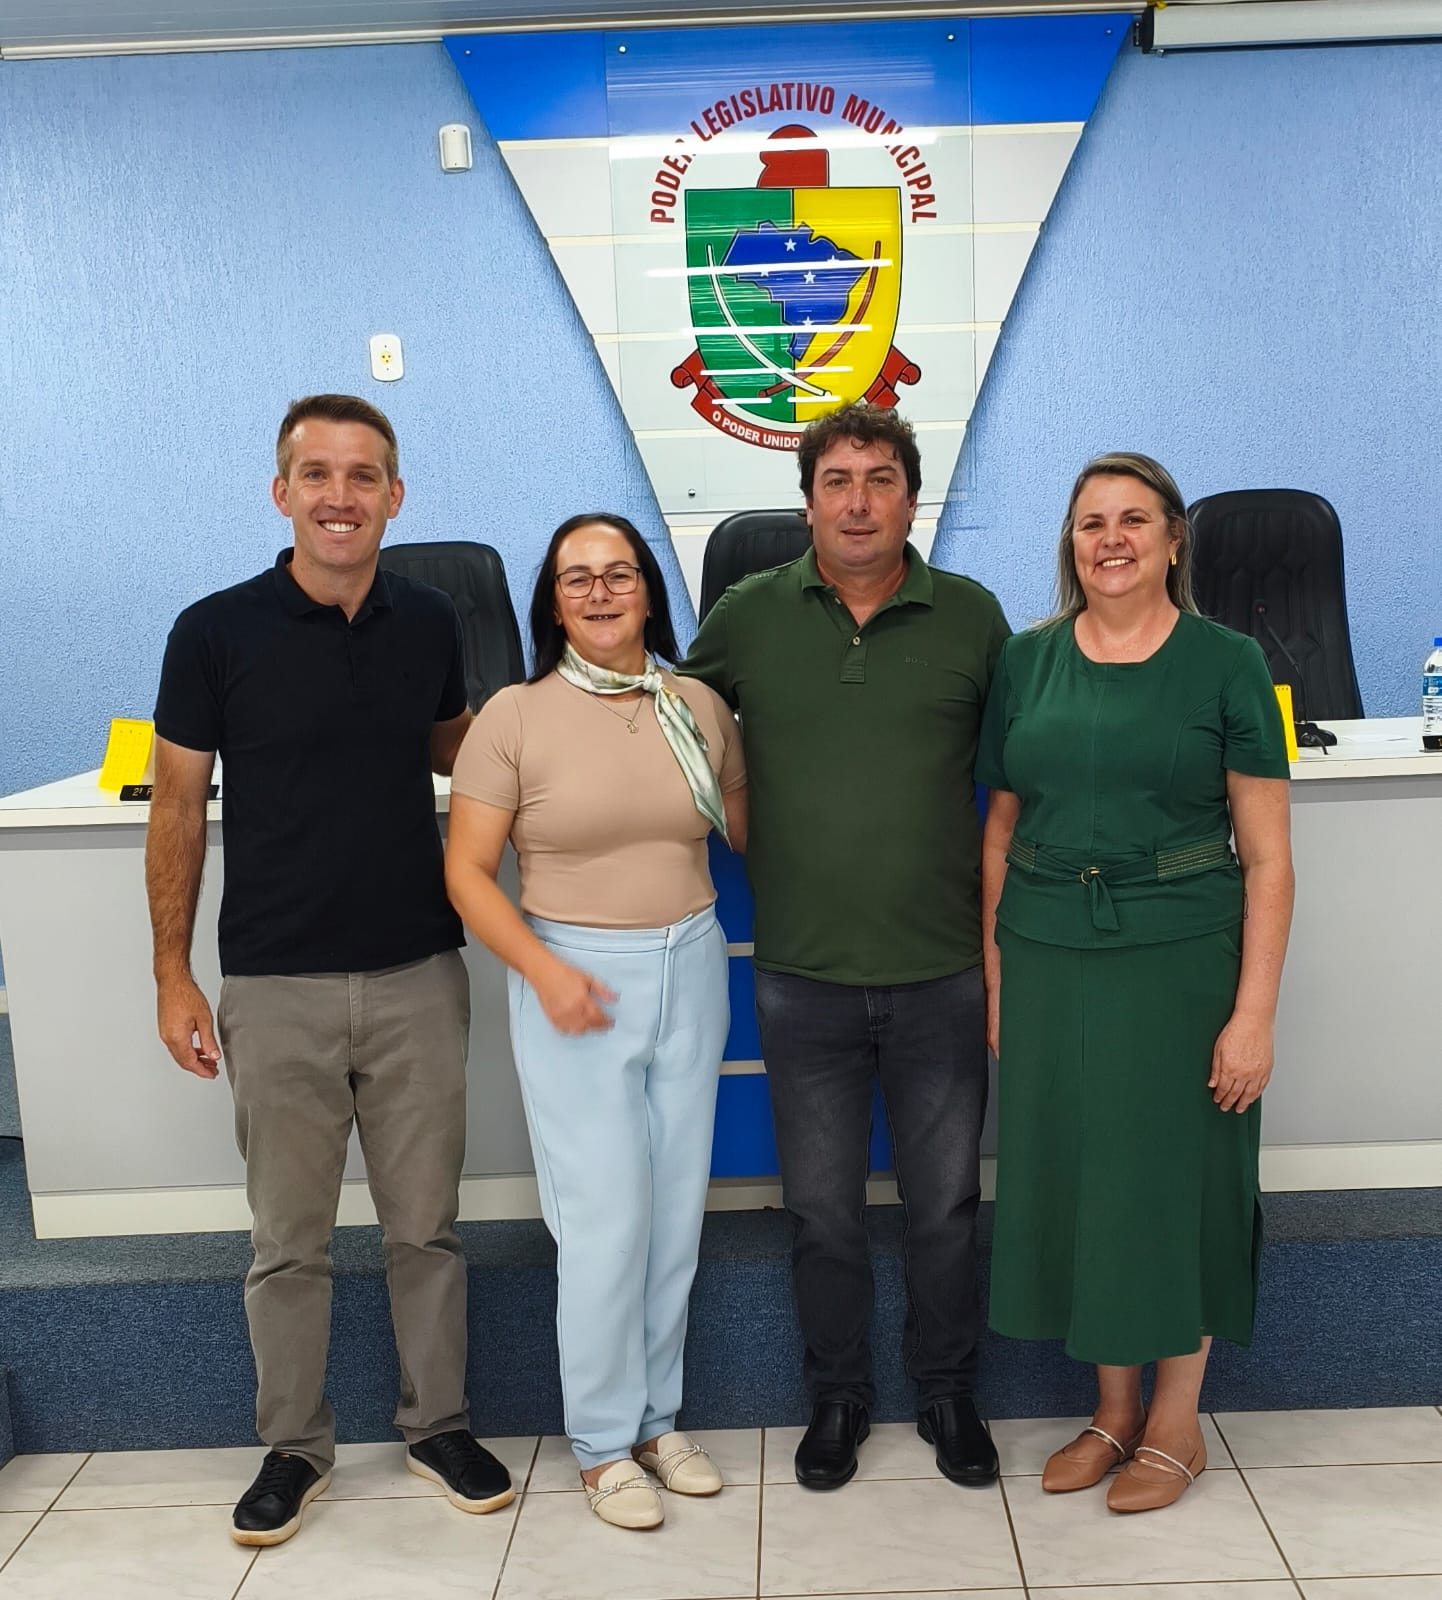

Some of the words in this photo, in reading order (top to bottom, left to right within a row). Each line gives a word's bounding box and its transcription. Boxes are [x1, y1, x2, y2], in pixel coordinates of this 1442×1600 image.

[690, 82, 835, 142] LEGISLATIVO
[712, 410, 722, 423] O
[722, 417, 760, 443] PODER
[763, 433, 800, 448] UNIDO
